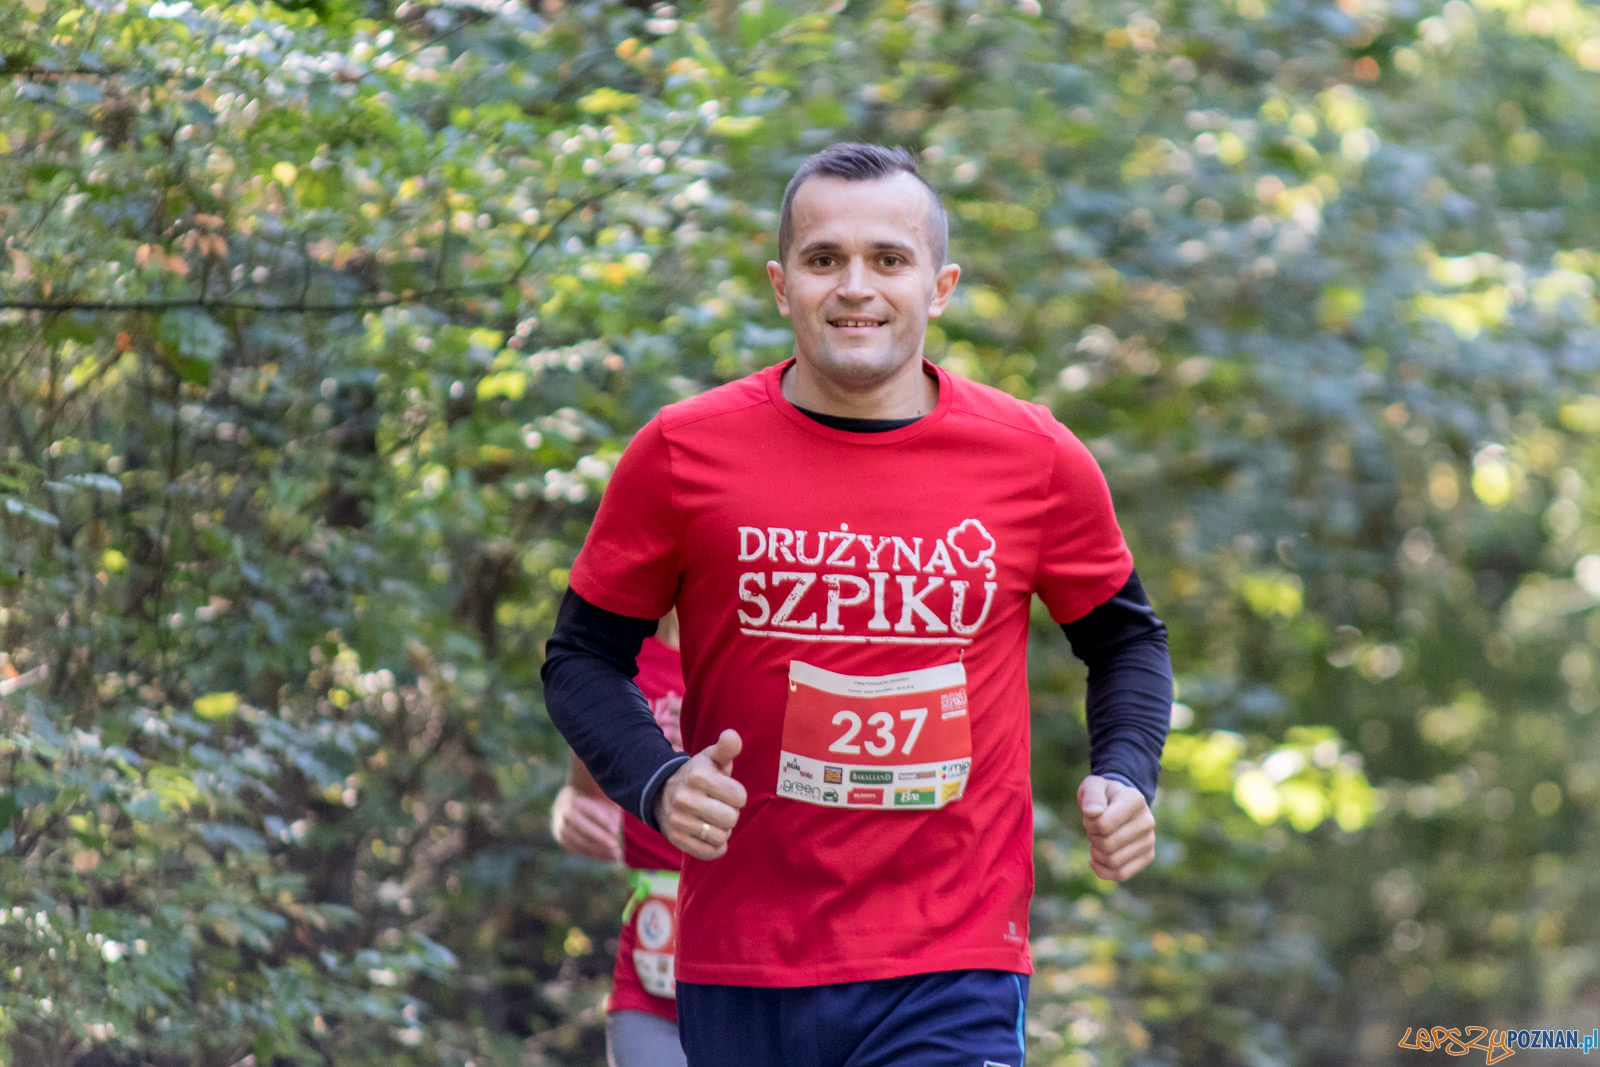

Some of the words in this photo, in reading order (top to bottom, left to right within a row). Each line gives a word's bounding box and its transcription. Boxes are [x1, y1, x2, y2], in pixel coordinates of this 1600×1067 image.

[738, 522, 957, 575] DRUŻYNA
[737, 571, 998, 635] SZPIKU
[828, 708, 928, 757] 237
[783, 779, 821, 800] green
